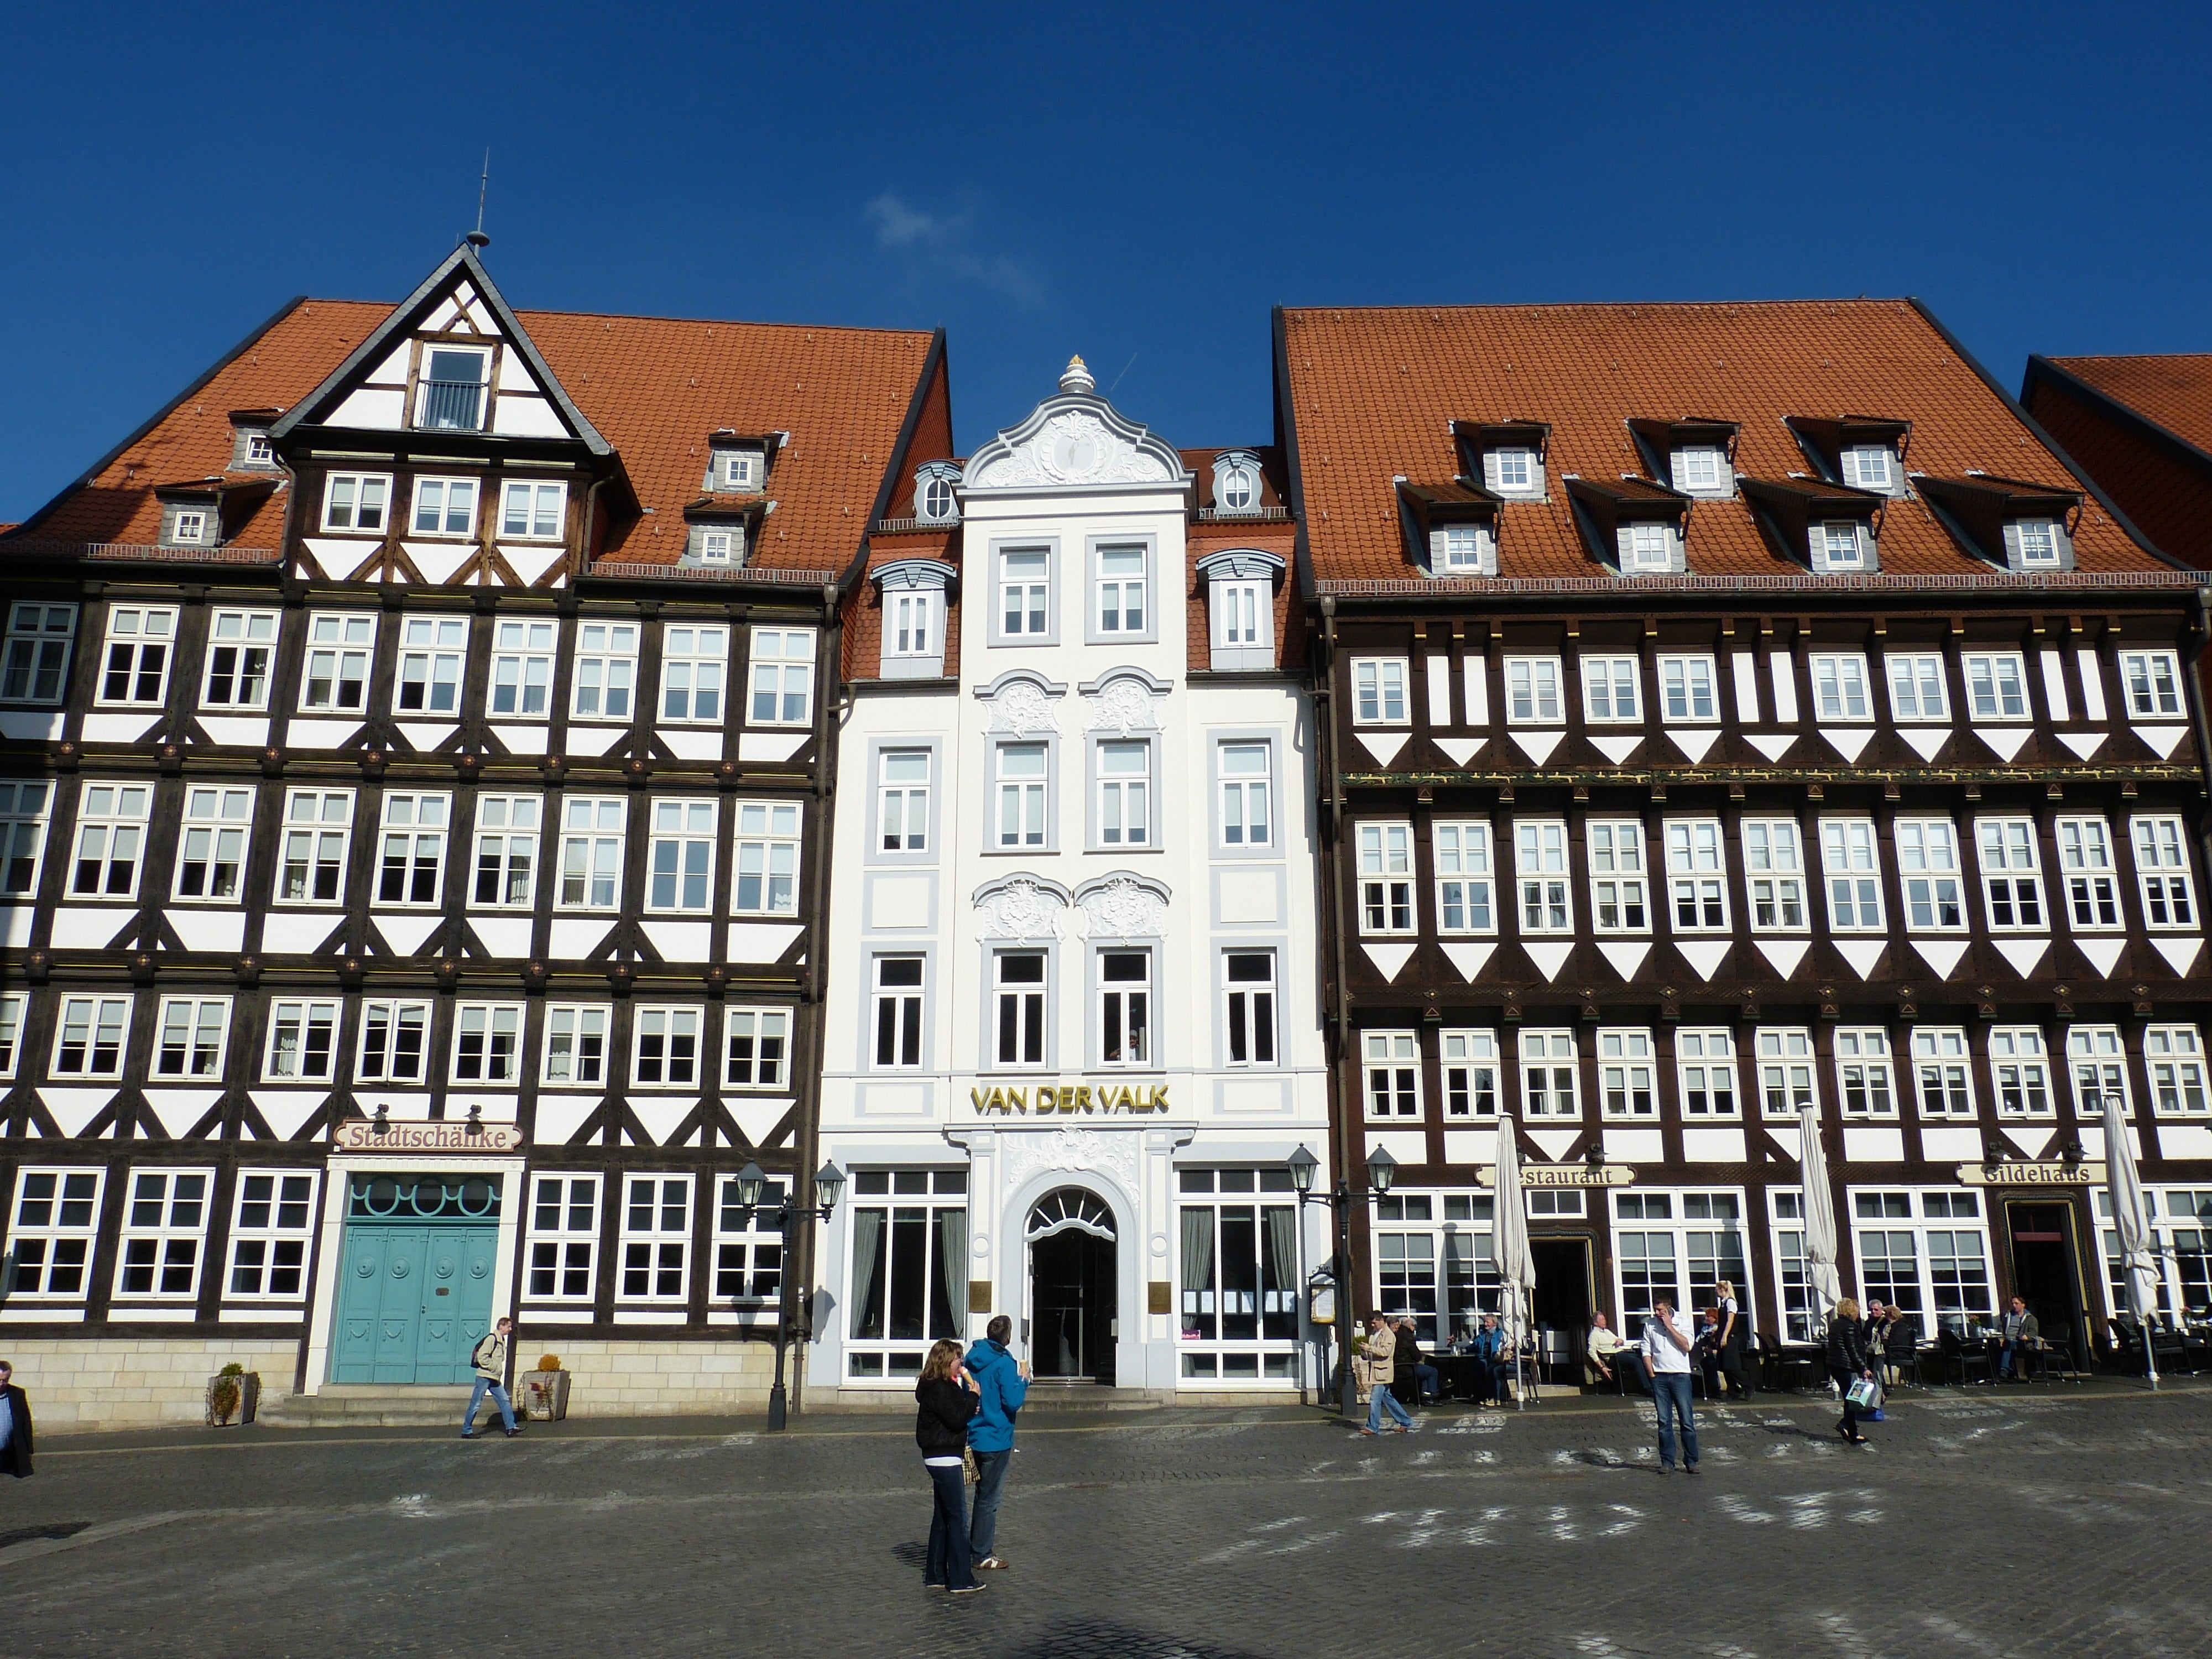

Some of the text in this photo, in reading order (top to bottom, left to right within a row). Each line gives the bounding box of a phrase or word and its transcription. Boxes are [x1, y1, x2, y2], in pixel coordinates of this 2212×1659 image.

[971, 1084, 1170, 1109] VAN DER VALK
[349, 1124, 507, 1148] Stadtschänke
[1519, 1168, 1613, 1184] estaurant
[1984, 1164, 2090, 1182] Gildehaus
